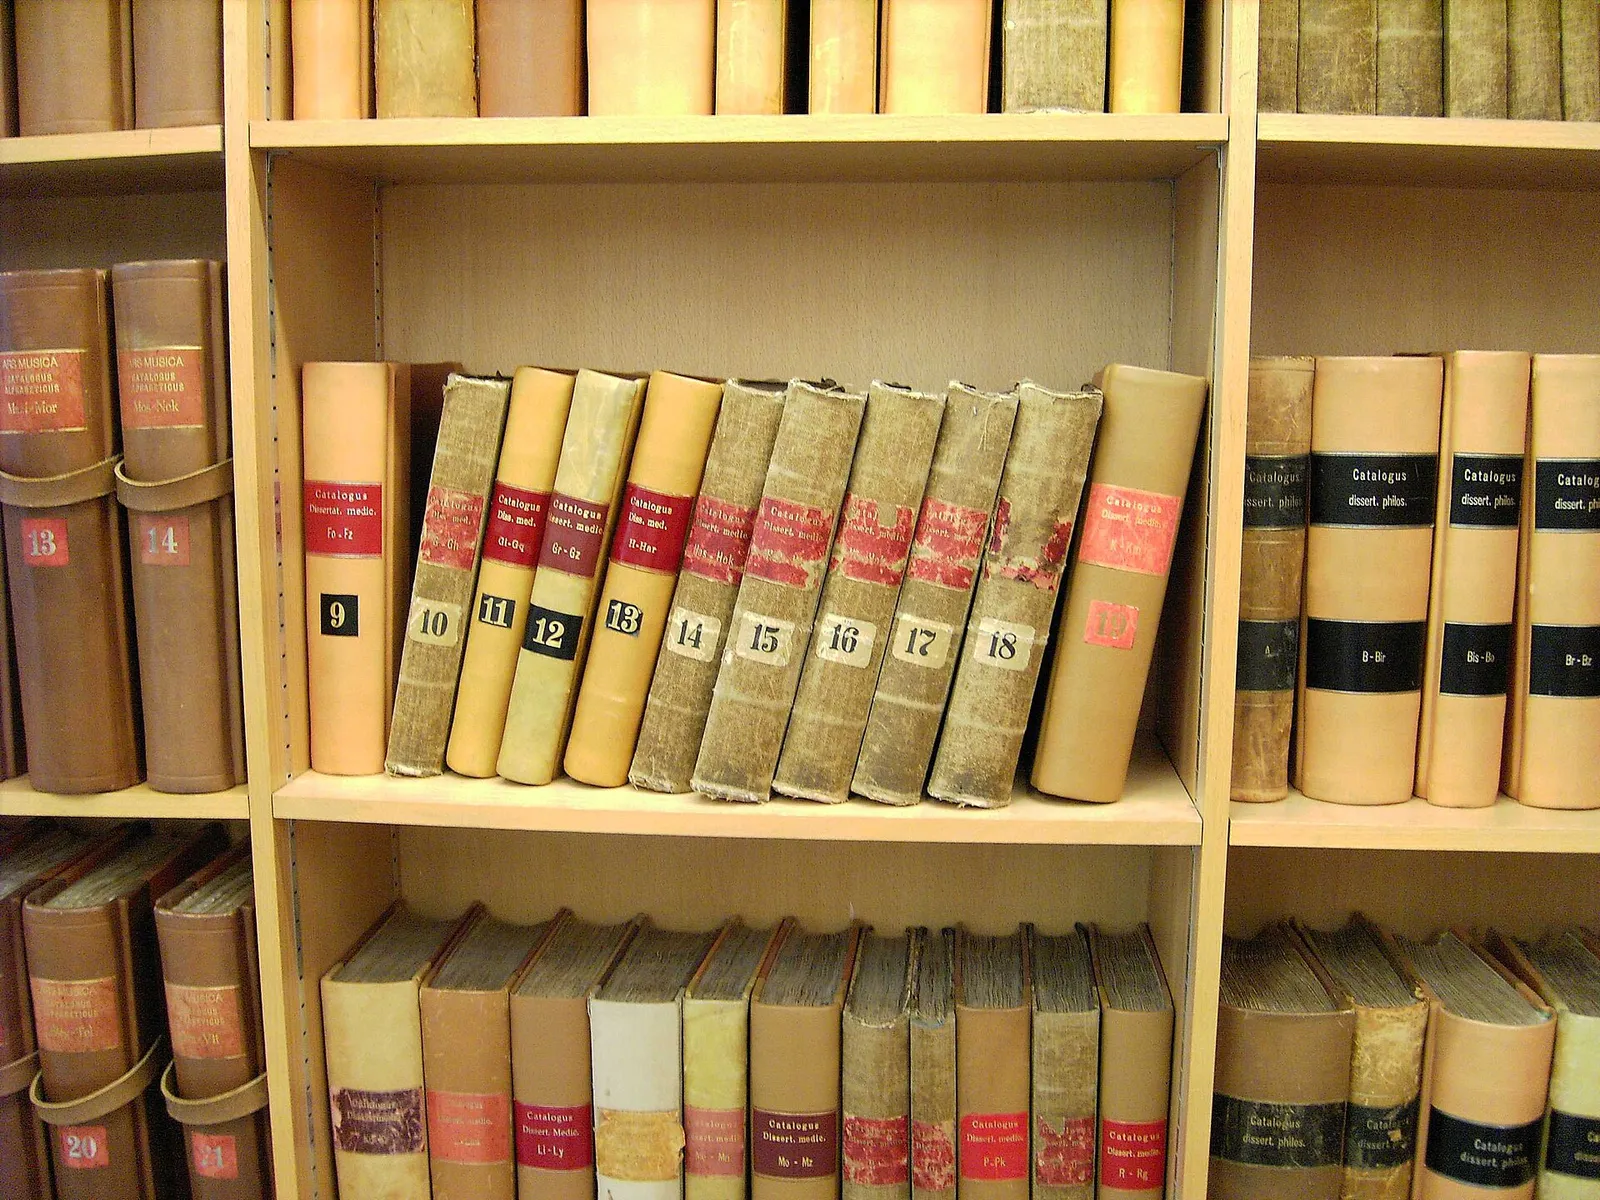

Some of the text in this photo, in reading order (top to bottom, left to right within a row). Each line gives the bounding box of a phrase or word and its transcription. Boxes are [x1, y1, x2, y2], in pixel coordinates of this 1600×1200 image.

[18, 356, 59, 369] MUSICA
[143, 356, 184, 368] MUSICA
[1249, 470, 1300, 485] Catalogus
[1353, 468, 1407, 484] Catalogus
[1464, 468, 1516, 485] Catalogus
[315, 490, 368, 502] Catalogus
[498, 494, 541, 512] Catalogus
[1106, 495, 1162, 514] Catalogus
[1349, 494, 1407, 510] dissert. philos.
[1461, 493, 1492, 506] dissert.
[1554, 498, 1586, 510] dissert.
[346, 506, 377, 516] medic.
[553, 499, 602, 520] Catalogus
[630, 496, 673, 515] Catalogus
[497, 509, 536, 527] Diss. med.
[628, 511, 667, 530] Diss. med.
[28, 529, 57, 556] 13
[148, 527, 178, 553] 14
[330, 602, 346, 628] 9
[481, 597, 507, 627] 11
[608, 602, 639, 633] 13
[420, 609, 448, 637] 10
[1096, 610, 1127, 641] 19
[532, 617, 565, 649] 12
[677, 619, 703, 649] 14
[750, 623, 780, 653] 15
[829, 623, 859, 653] 16
[905, 627, 936, 657] 17
[988, 630, 1017, 660] 18
[526, 1110, 573, 1123] Catalogus
[768, 1119, 819, 1131] Catalogus
[972, 1120, 1019, 1129] Catalogus
[1250, 1115, 1300, 1131] Catalogus
[522, 1124, 580, 1138] Dissert. Medic.
[763, 1131, 826, 1143] Dissert. medic.
[1109, 1131, 1160, 1143] Catalogus
[67, 1135, 97, 1159] 20
[1242, 1133, 1306, 1149] dissert. philos.
[200, 1145, 224, 1168] 21
[1107, 1146, 1136, 1158] Dissert.
